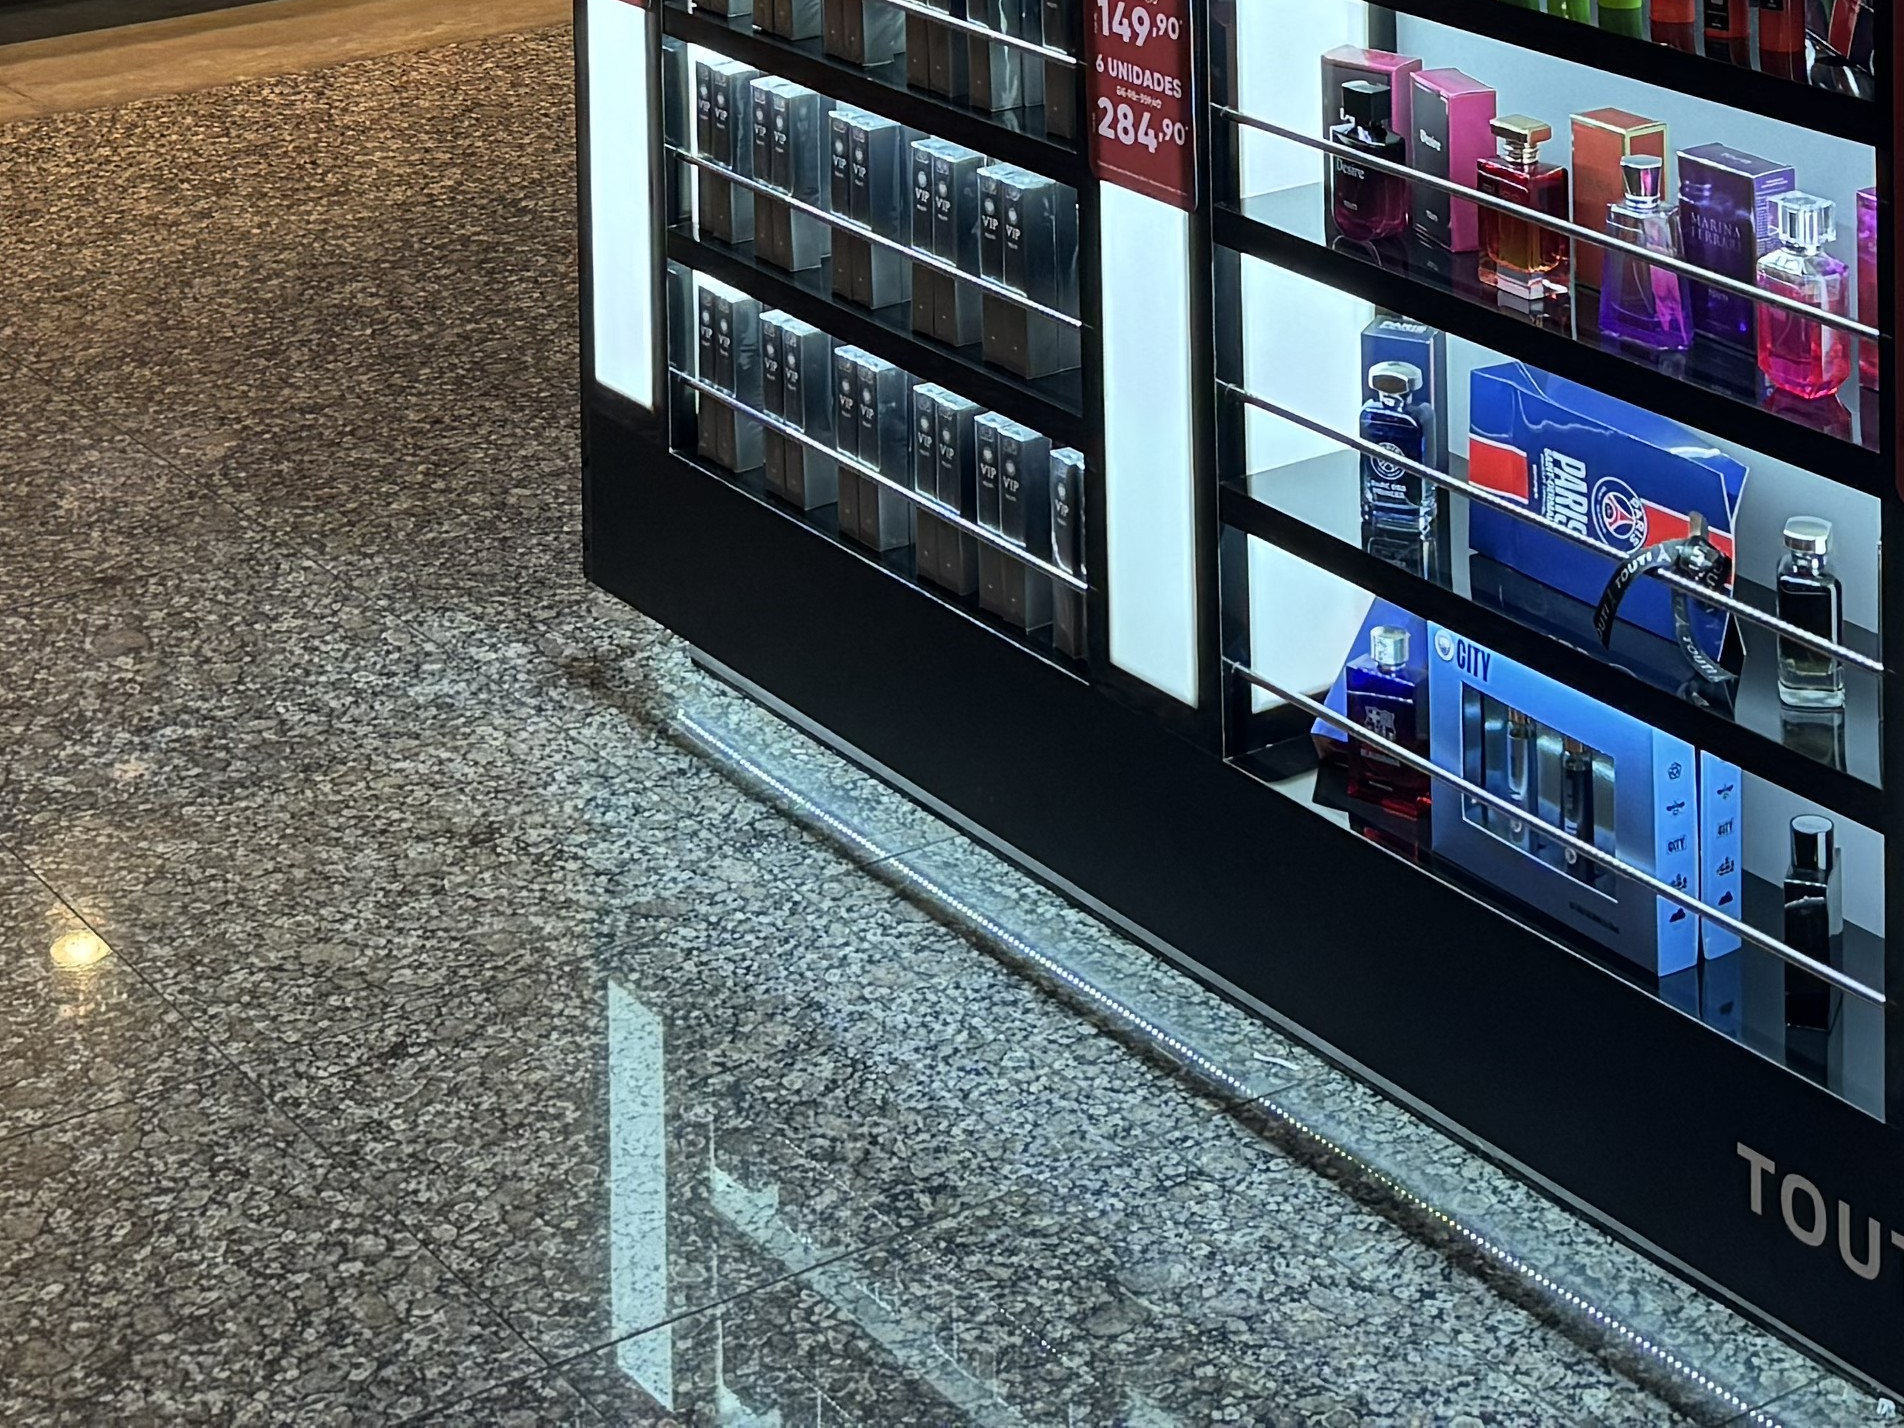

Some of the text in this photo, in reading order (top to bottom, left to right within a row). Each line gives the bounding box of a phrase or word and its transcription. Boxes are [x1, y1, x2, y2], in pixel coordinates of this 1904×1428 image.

[1096, 54, 1182, 98] 6 UNIDADES
[1336, 159, 1364, 179] Desire
[1691, 212, 1741, 238] MARINA
[1615, 552, 1652, 590] TOUTI
[1456, 638, 1491, 682] CITY
